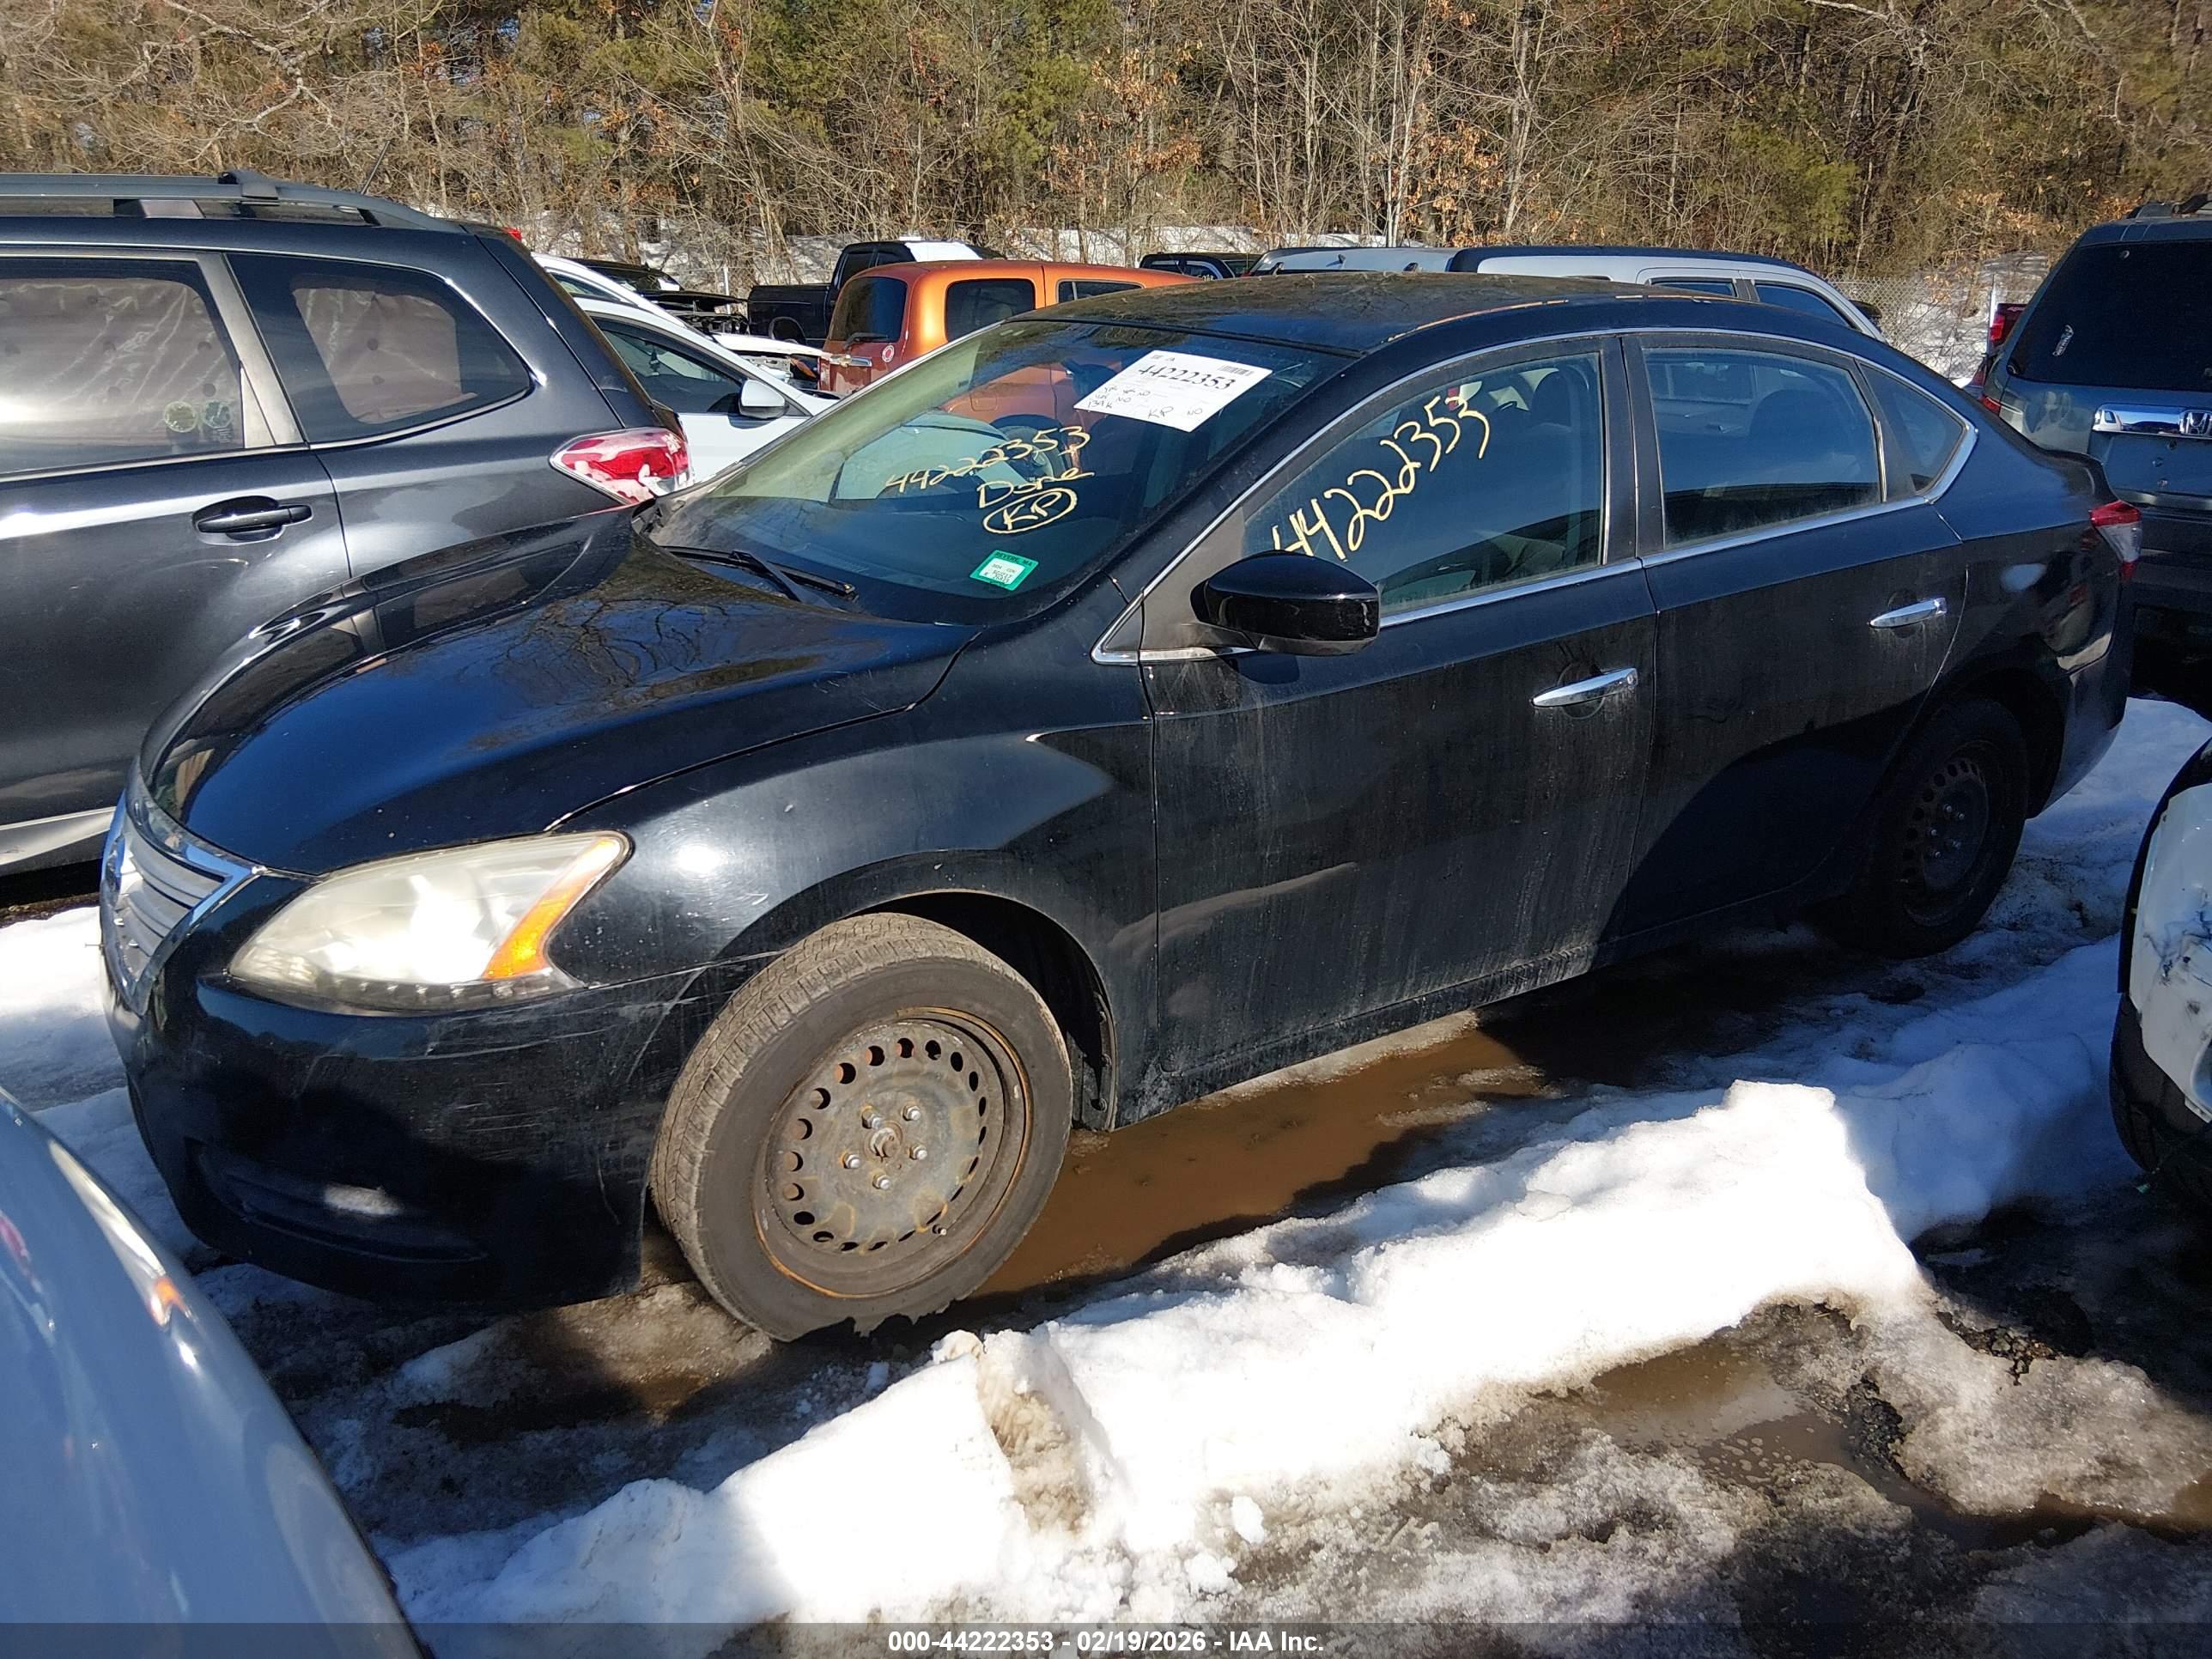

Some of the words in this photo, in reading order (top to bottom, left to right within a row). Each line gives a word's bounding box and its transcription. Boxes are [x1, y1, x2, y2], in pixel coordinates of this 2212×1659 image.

[1139, 364, 1236, 390] 44222353
[885, 426, 1091, 493] 44222353
[1272, 396, 1490, 562] 44222353
